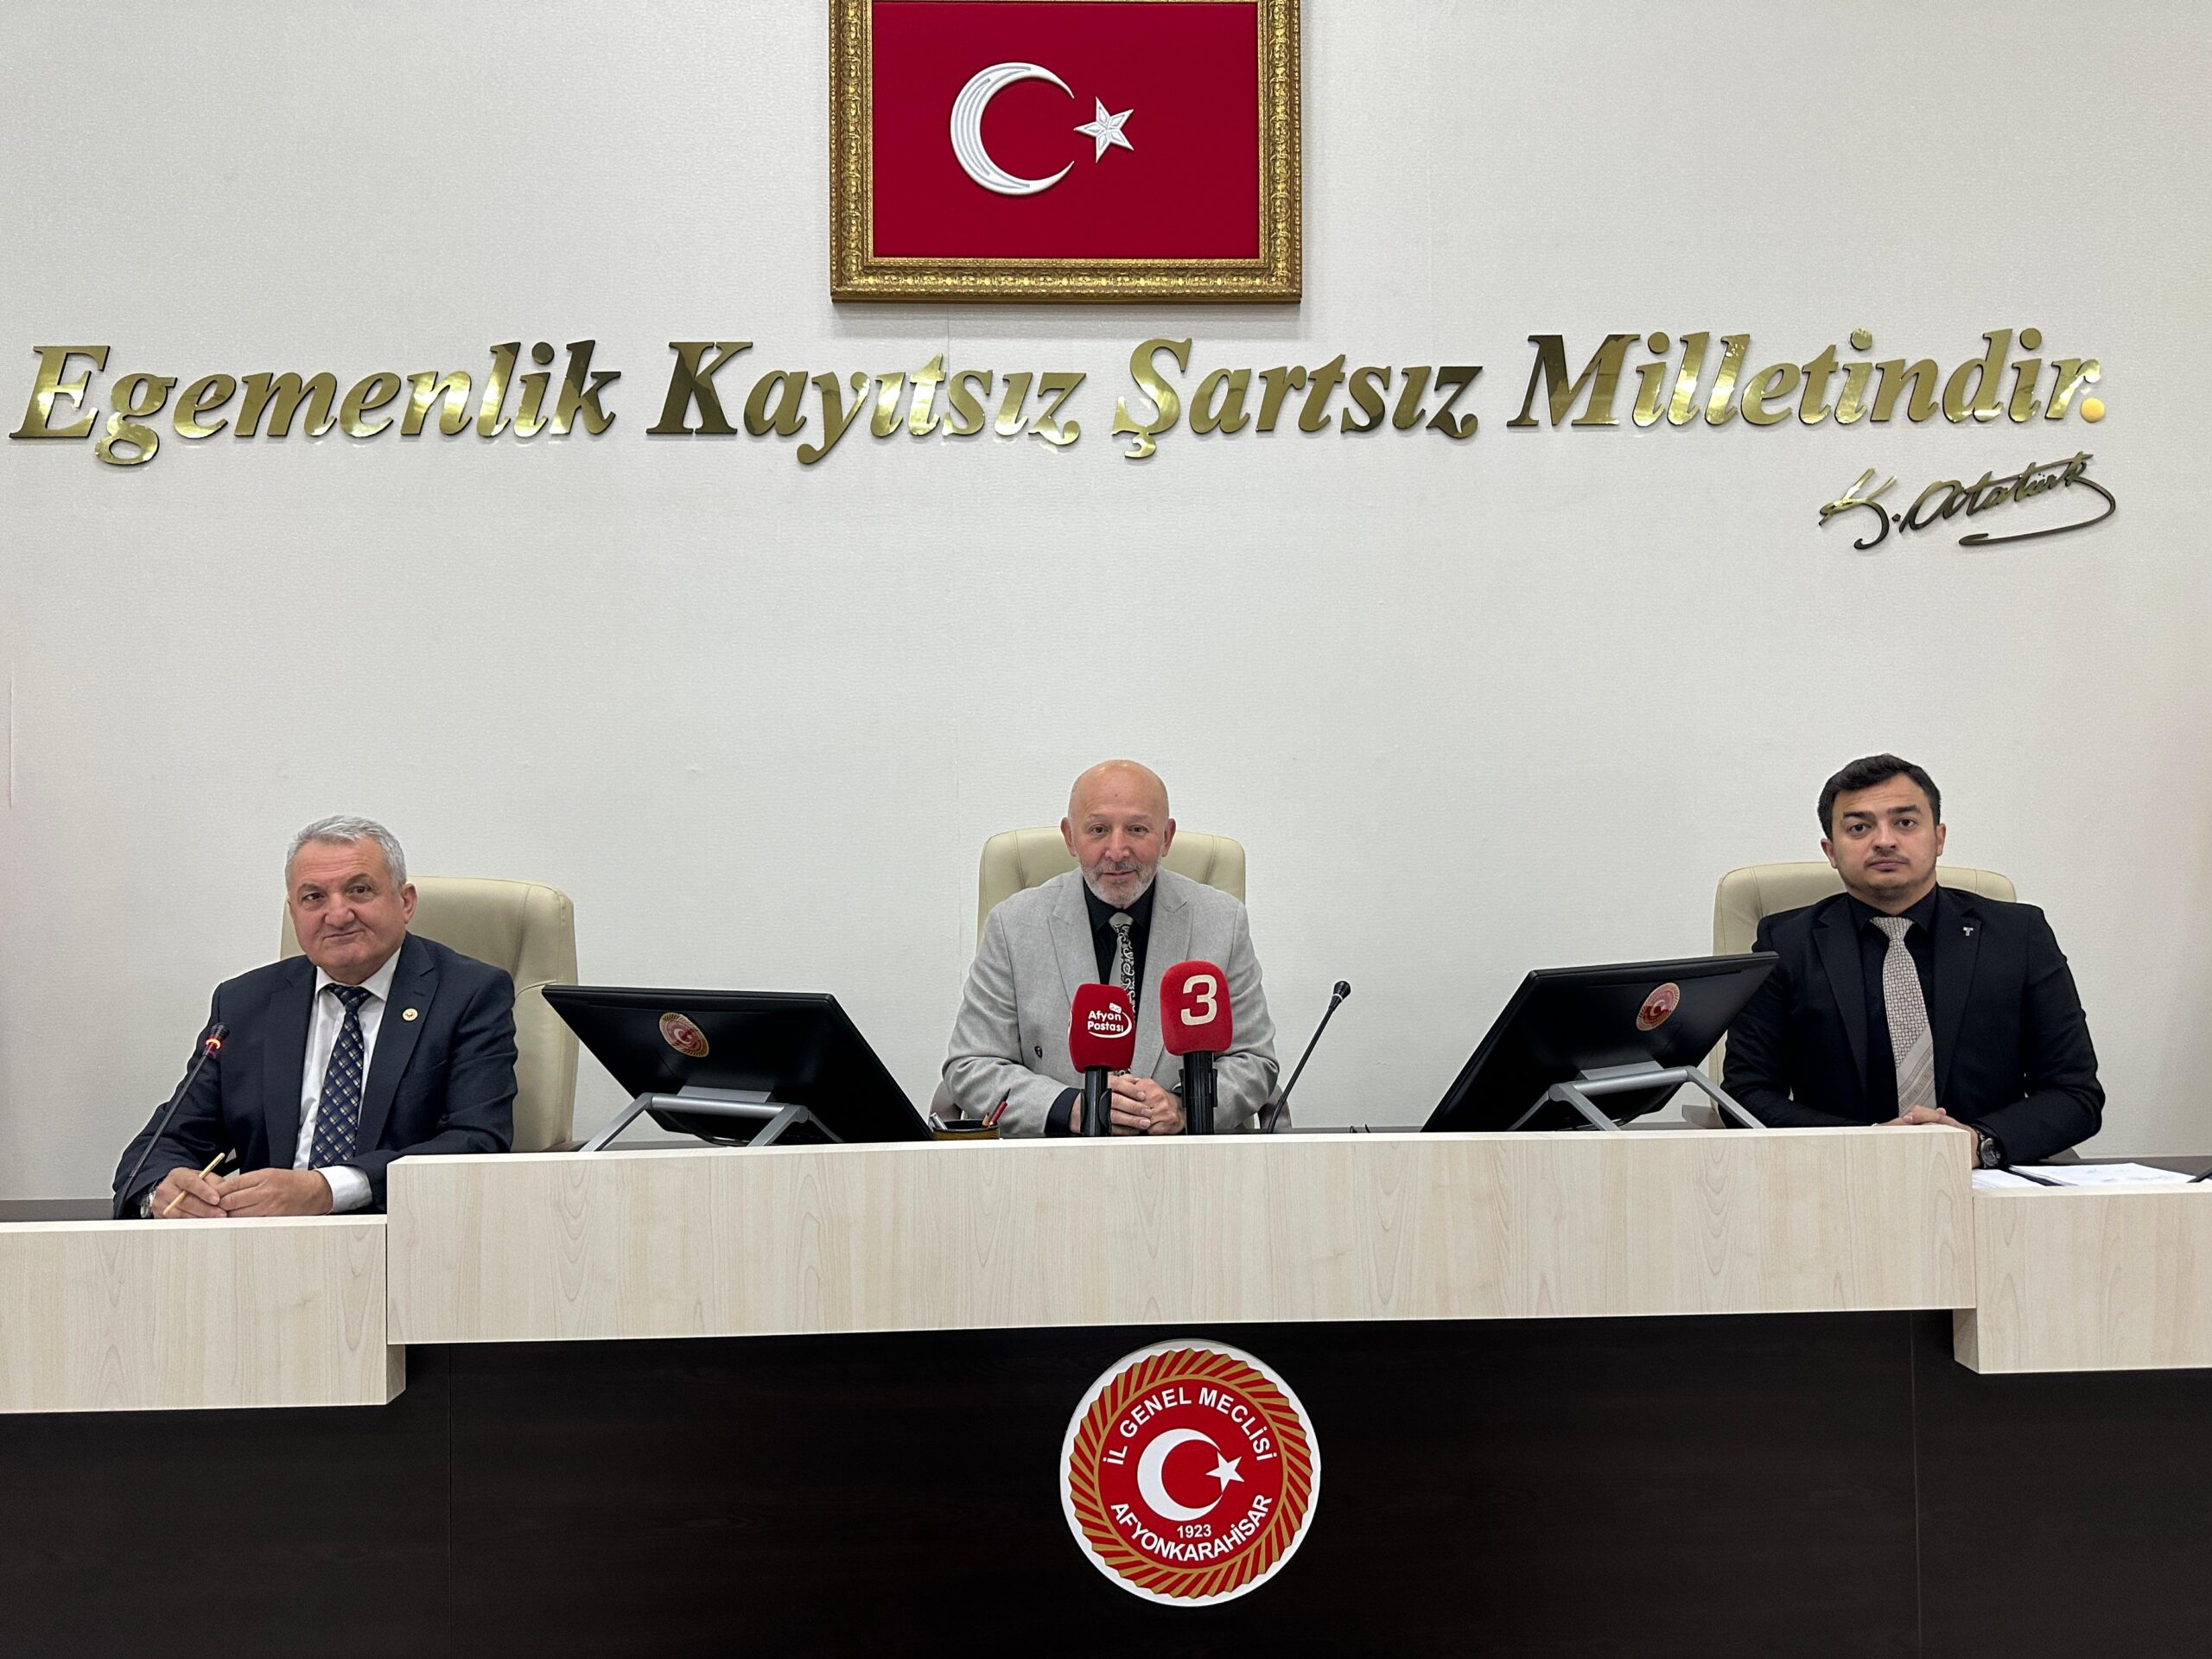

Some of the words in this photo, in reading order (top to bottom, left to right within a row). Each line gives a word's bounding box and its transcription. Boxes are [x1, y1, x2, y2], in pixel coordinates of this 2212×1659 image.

[10, 340, 621, 465] Egemenlik
[646, 340, 1087, 465] Kayıtsız
[1112, 338, 1484, 459] Şartsız
[1507, 327, 2106, 427] Milletindir.
[1088, 1010, 1122, 1021] Afyon
[1181, 974, 1217, 1026] 3
[1087, 1021, 1124, 1033] Postası
[1103, 1444, 1128, 1465] İL
[1119, 1387, 1192, 1438] GENEL
[1198, 1387, 1278, 1461] MECLİSİ
[1110, 1494, 1273, 1561] AFYONKARAHİSAR
[1176, 1523, 1212, 1538] 1923
